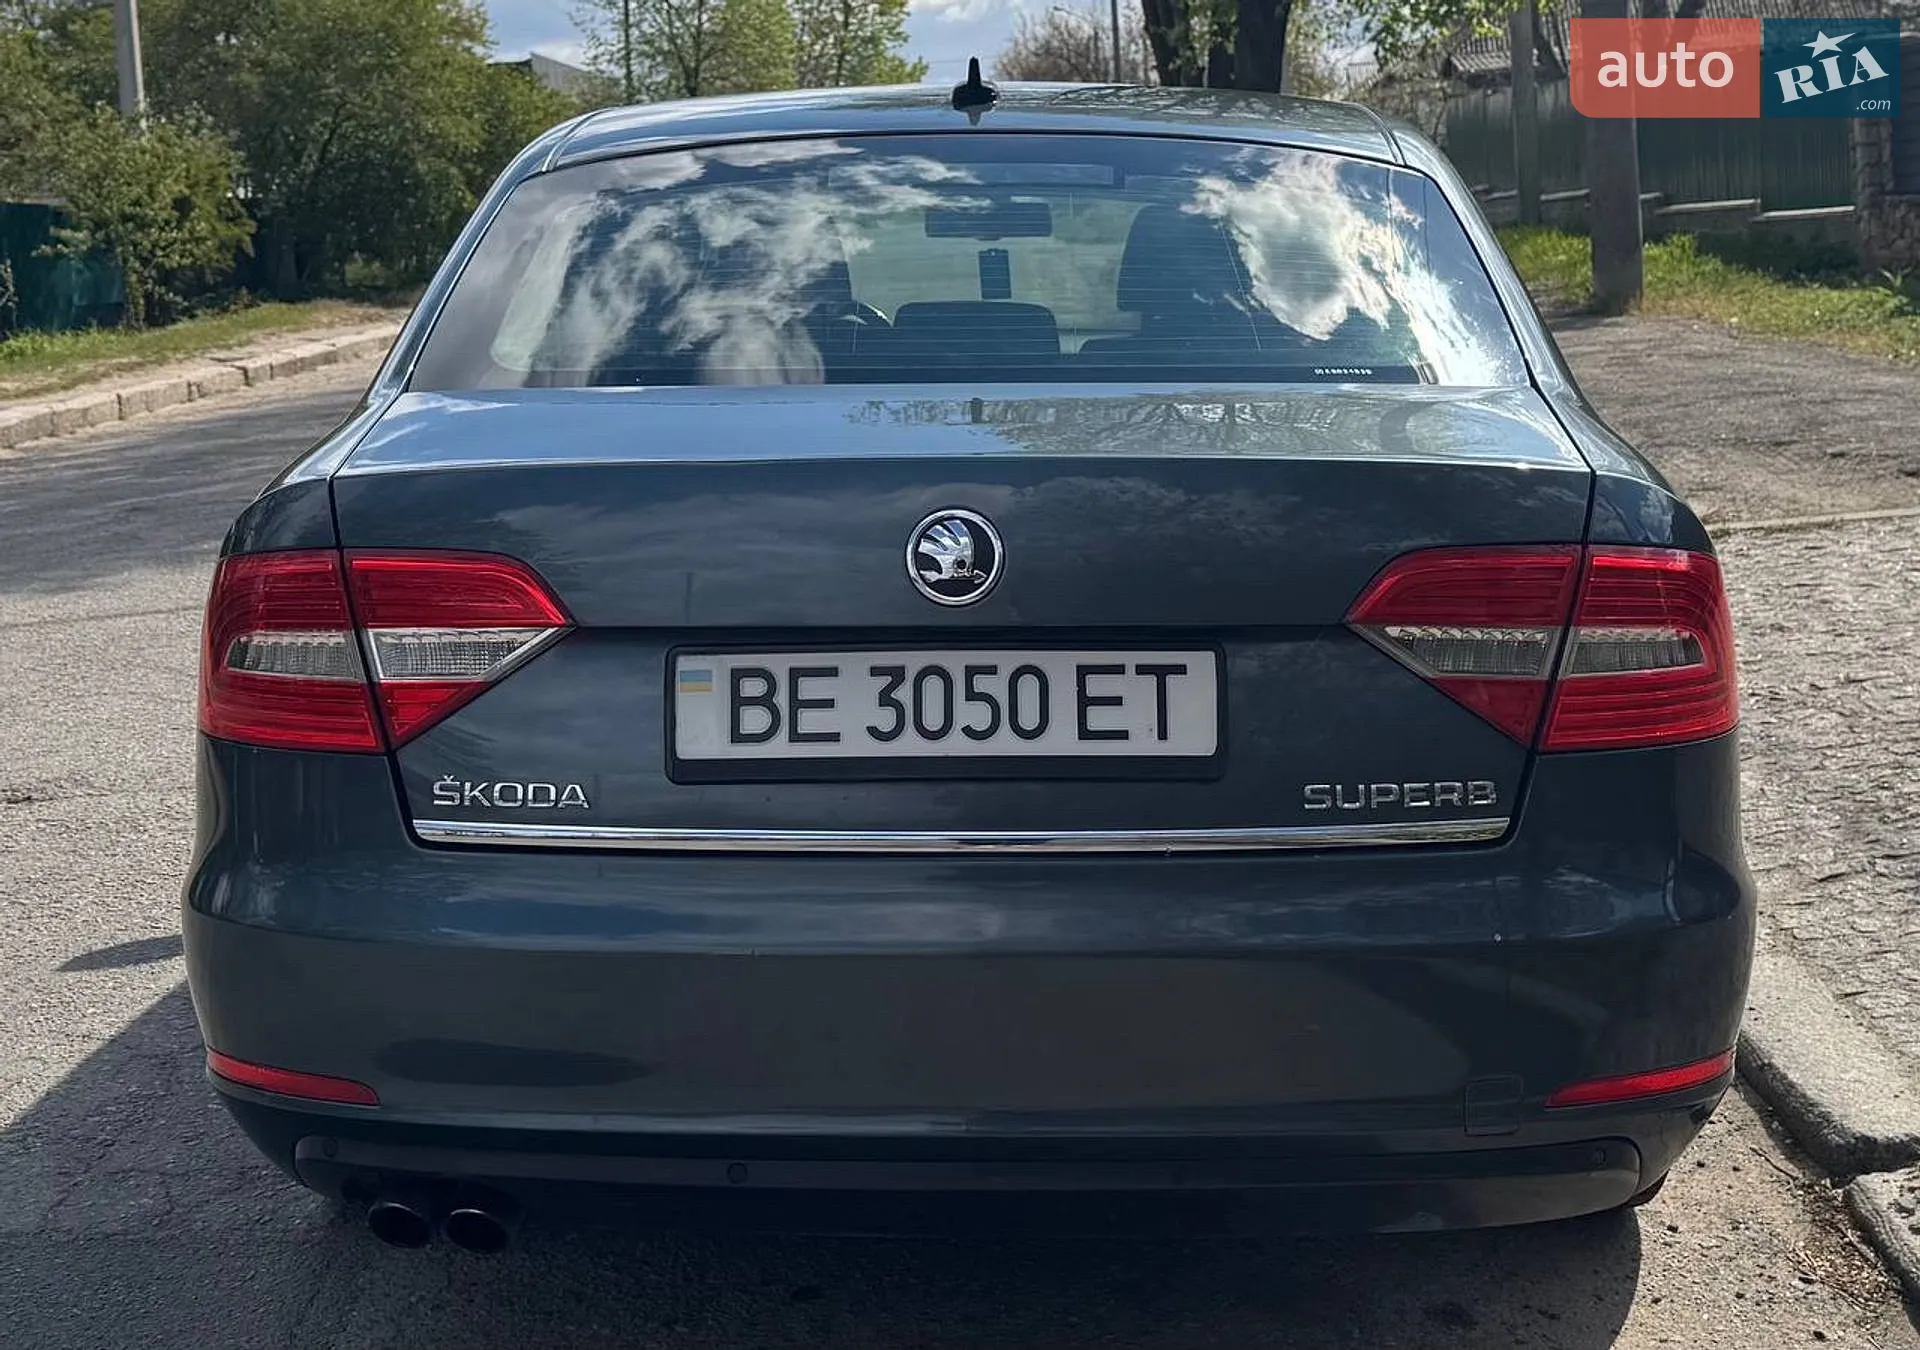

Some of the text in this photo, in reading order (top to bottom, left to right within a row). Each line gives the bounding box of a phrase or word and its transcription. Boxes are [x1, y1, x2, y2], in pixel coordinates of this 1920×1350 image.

[730, 664, 1188, 744] BE 3050 ET
[433, 774, 589, 809] ŠKODA
[1303, 780, 1497, 810] SUPERB
